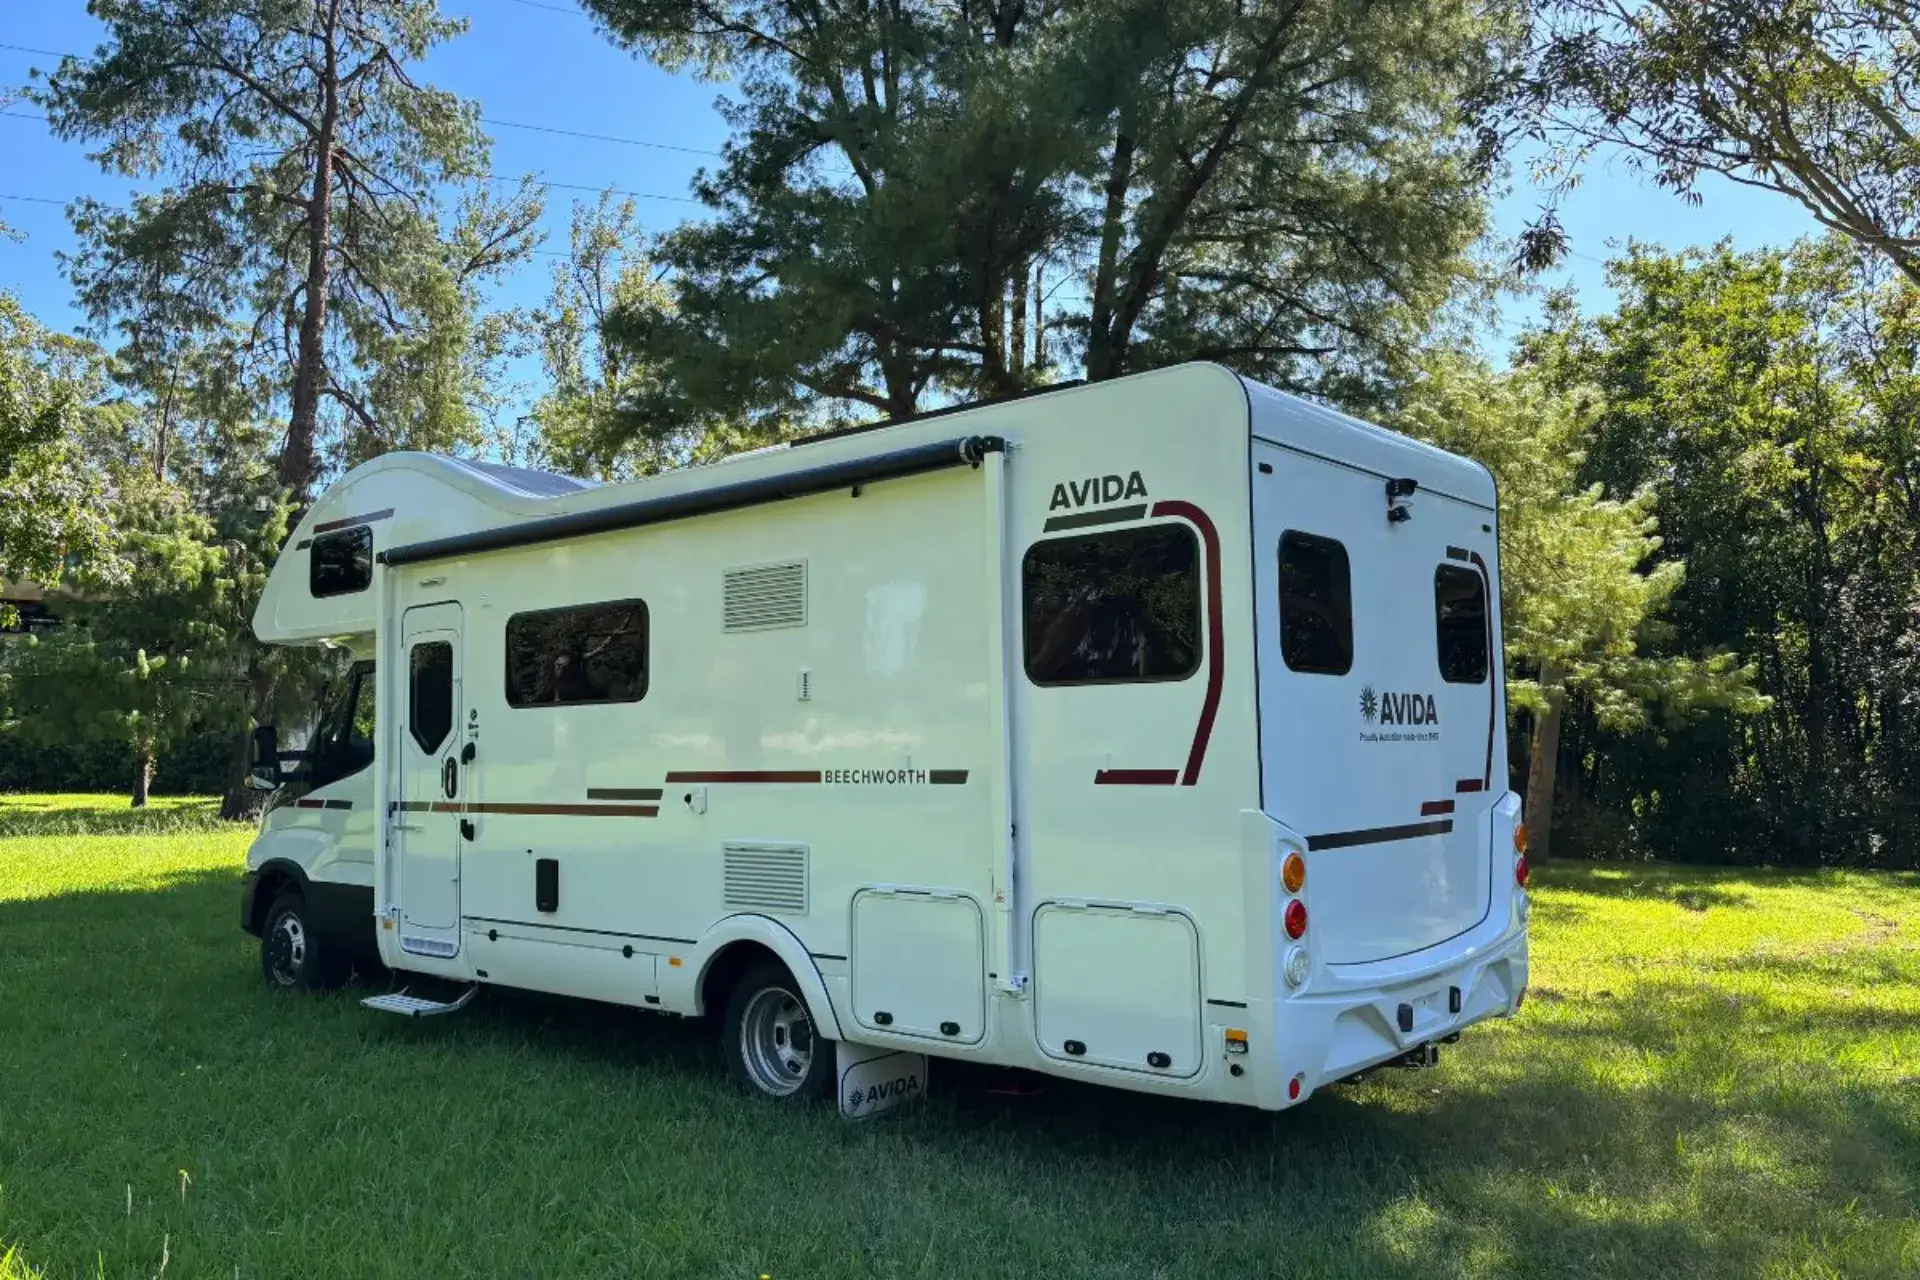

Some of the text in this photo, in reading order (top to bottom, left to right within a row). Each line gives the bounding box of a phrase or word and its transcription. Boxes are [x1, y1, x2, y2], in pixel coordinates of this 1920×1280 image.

[1049, 470, 1148, 511] AVIDA
[1380, 692, 1439, 725] AVIDA
[825, 769, 926, 784] BEECHWORTH
[866, 1074, 918, 1103] AVIDA
